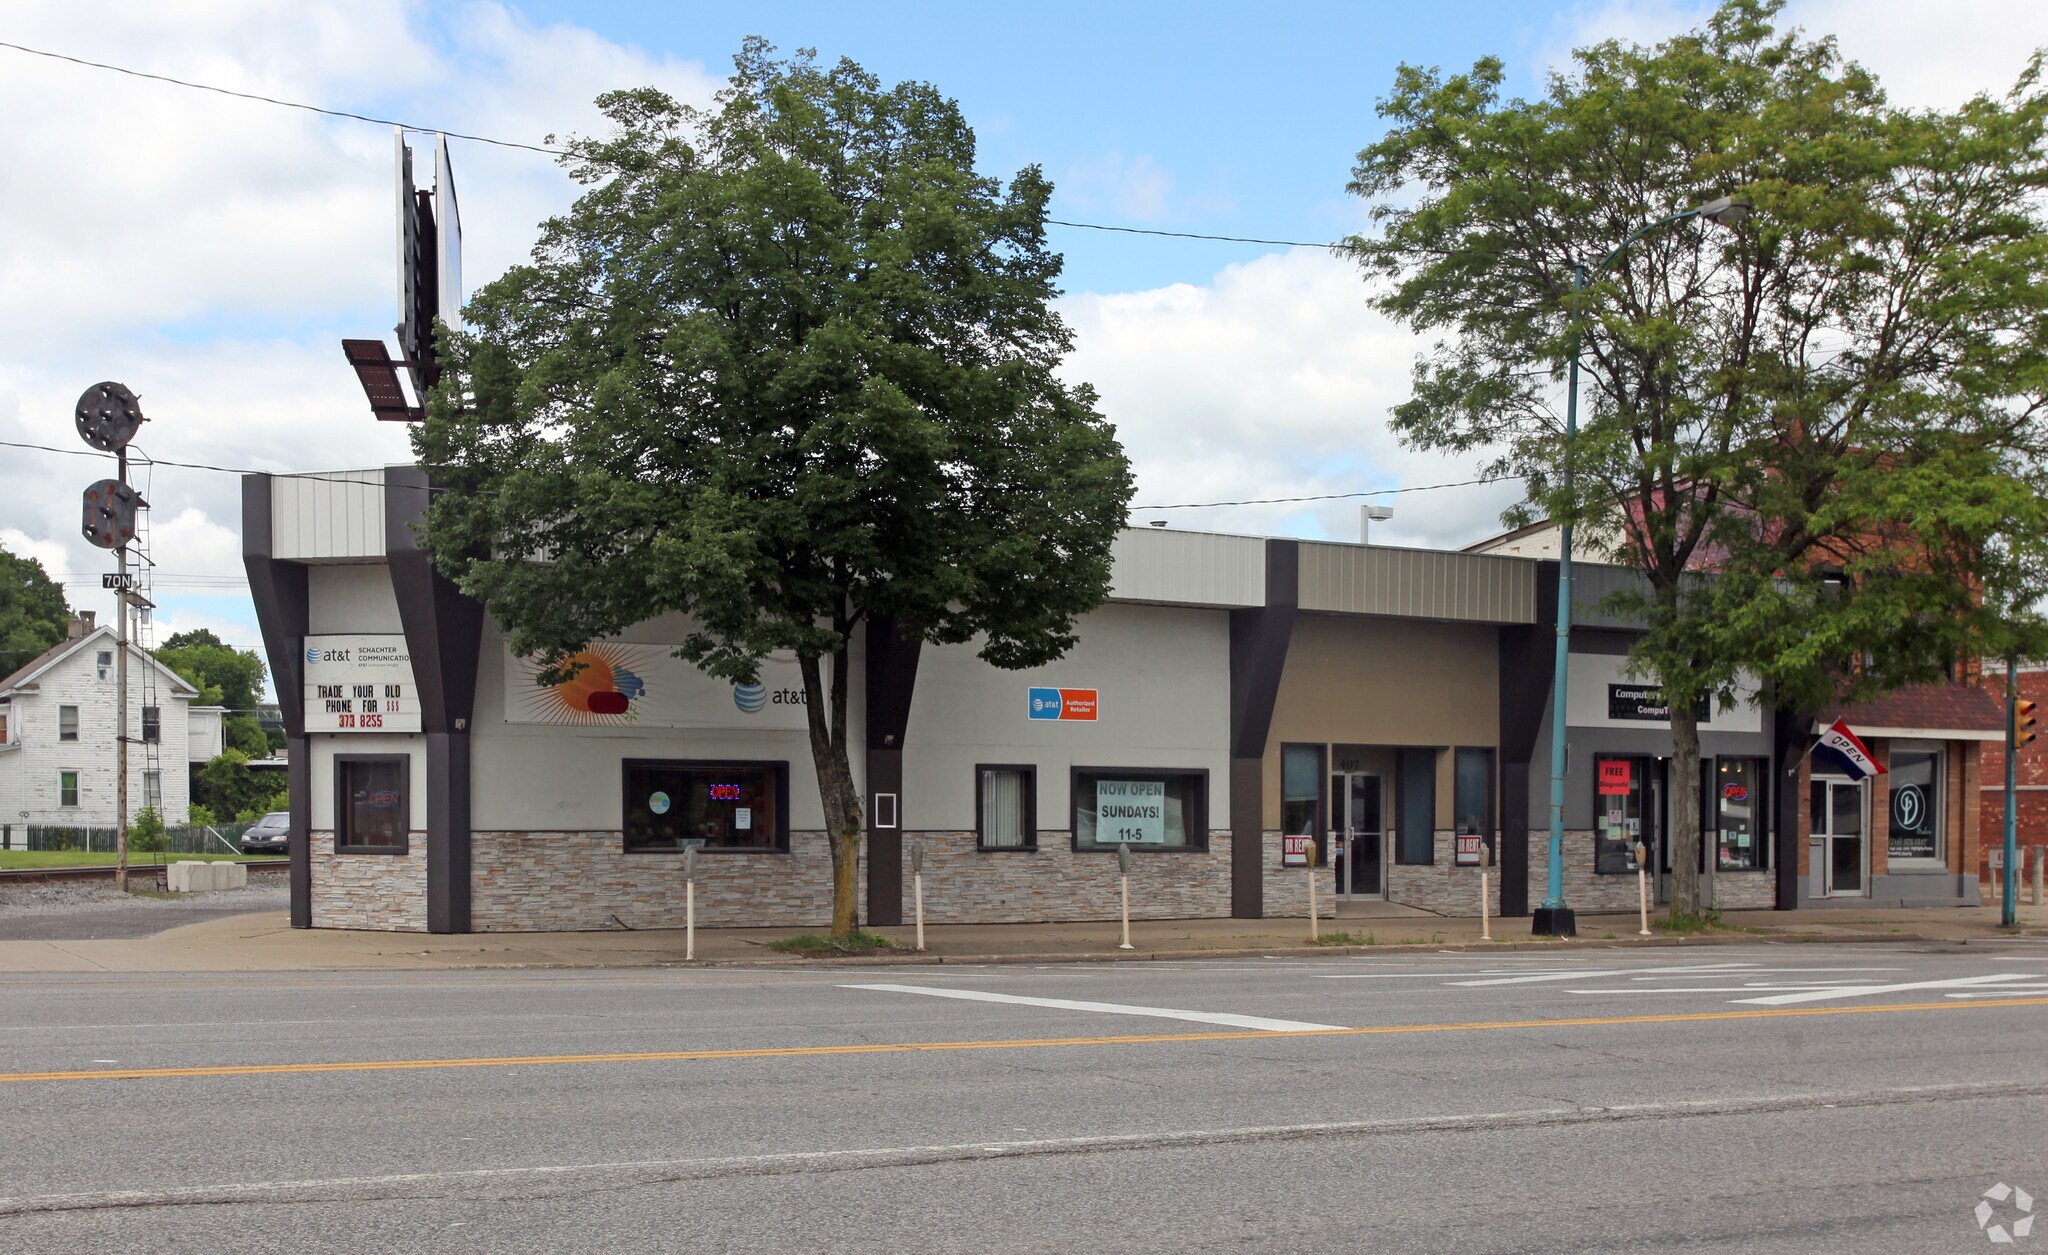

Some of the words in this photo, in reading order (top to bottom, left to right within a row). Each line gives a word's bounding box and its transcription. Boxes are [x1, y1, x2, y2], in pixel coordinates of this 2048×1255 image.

[323, 648, 350, 662] at&t
[317, 685, 343, 698] TRADE
[352, 685, 374, 698] YOUR
[384, 685, 401, 698] OLD
[772, 688, 808, 704] at&t
[326, 700, 352, 713] PHONE
[362, 700, 378, 713] FOR
[386, 701, 400, 712] $$$
[1044, 700, 1059, 708] at&t
[1637, 705, 1669, 716] CompuT
[339, 715, 355, 728] 373
[360, 714, 383, 728] 8255
[1831, 736, 1865, 763] OPEN
[1605, 767, 1624, 776] FREE
[711, 785, 739, 799] OPEN
[1100, 782, 1127, 796] NOW
[1130, 783, 1162, 796] OPEN
[1723, 785, 1747, 798] OPEN
[368, 792, 399, 804] OPEN
[1101, 805, 1159, 818] SUNDAYS!
[1119, 828, 1142, 840] 11-5
[1285, 838, 1294, 853] OR
[1457, 838, 1465, 852] OR
